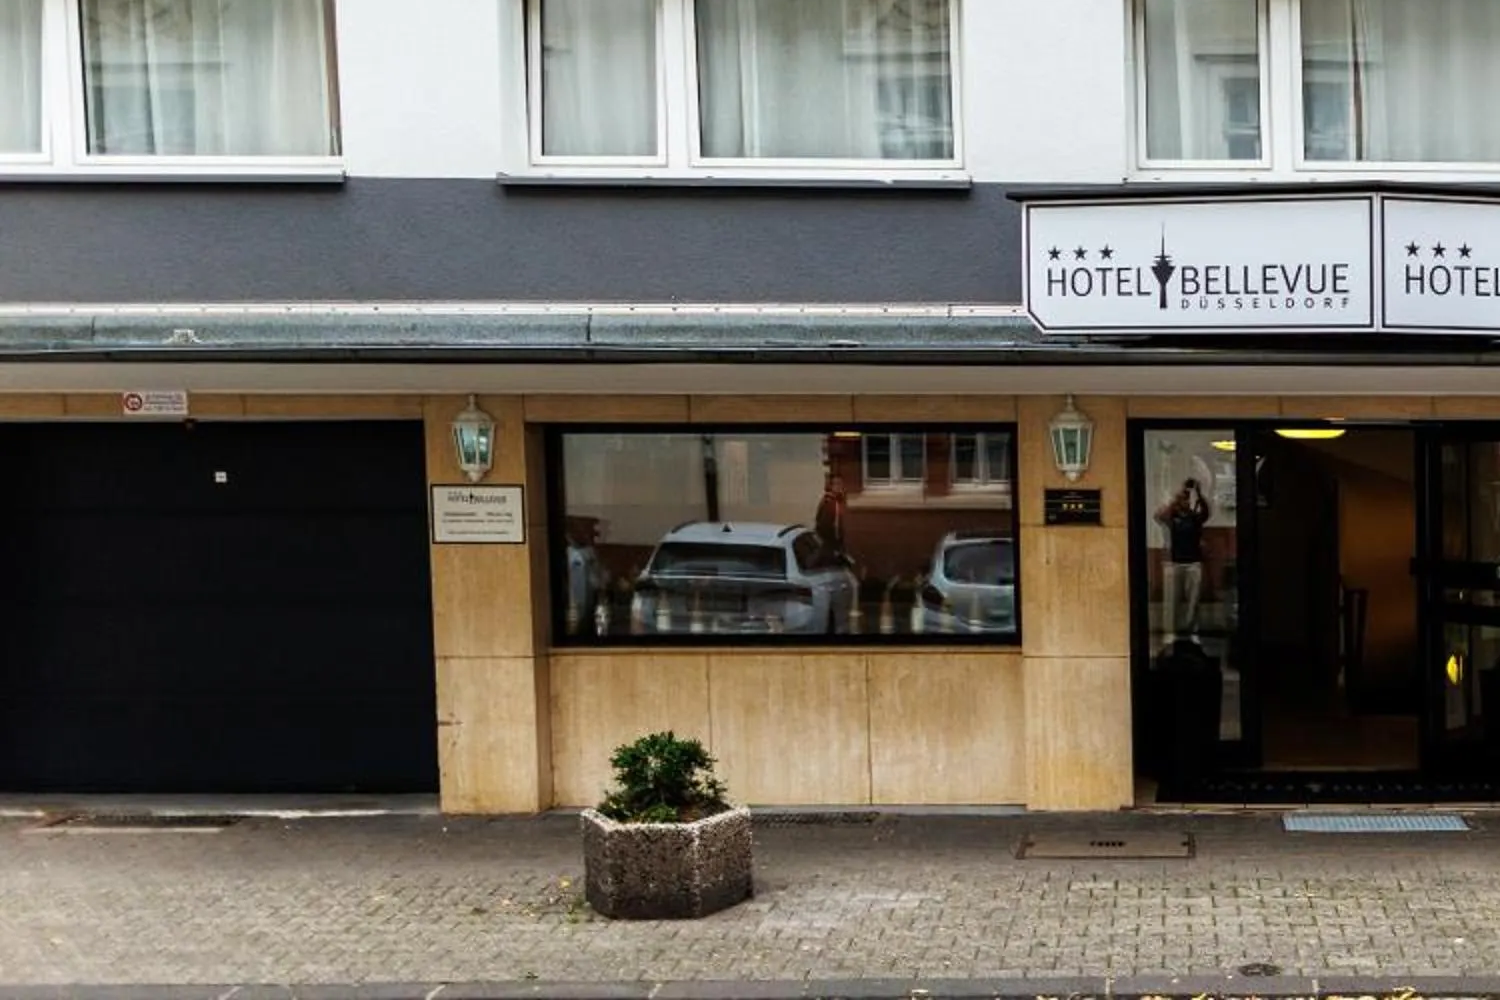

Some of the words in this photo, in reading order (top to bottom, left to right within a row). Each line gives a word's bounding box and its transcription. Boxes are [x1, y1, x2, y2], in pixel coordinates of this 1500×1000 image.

[1046, 266, 1152, 297] HOTEL
[1181, 263, 1350, 295] BELLEVUE
[1181, 296, 1351, 310] DÜSSELDORF
